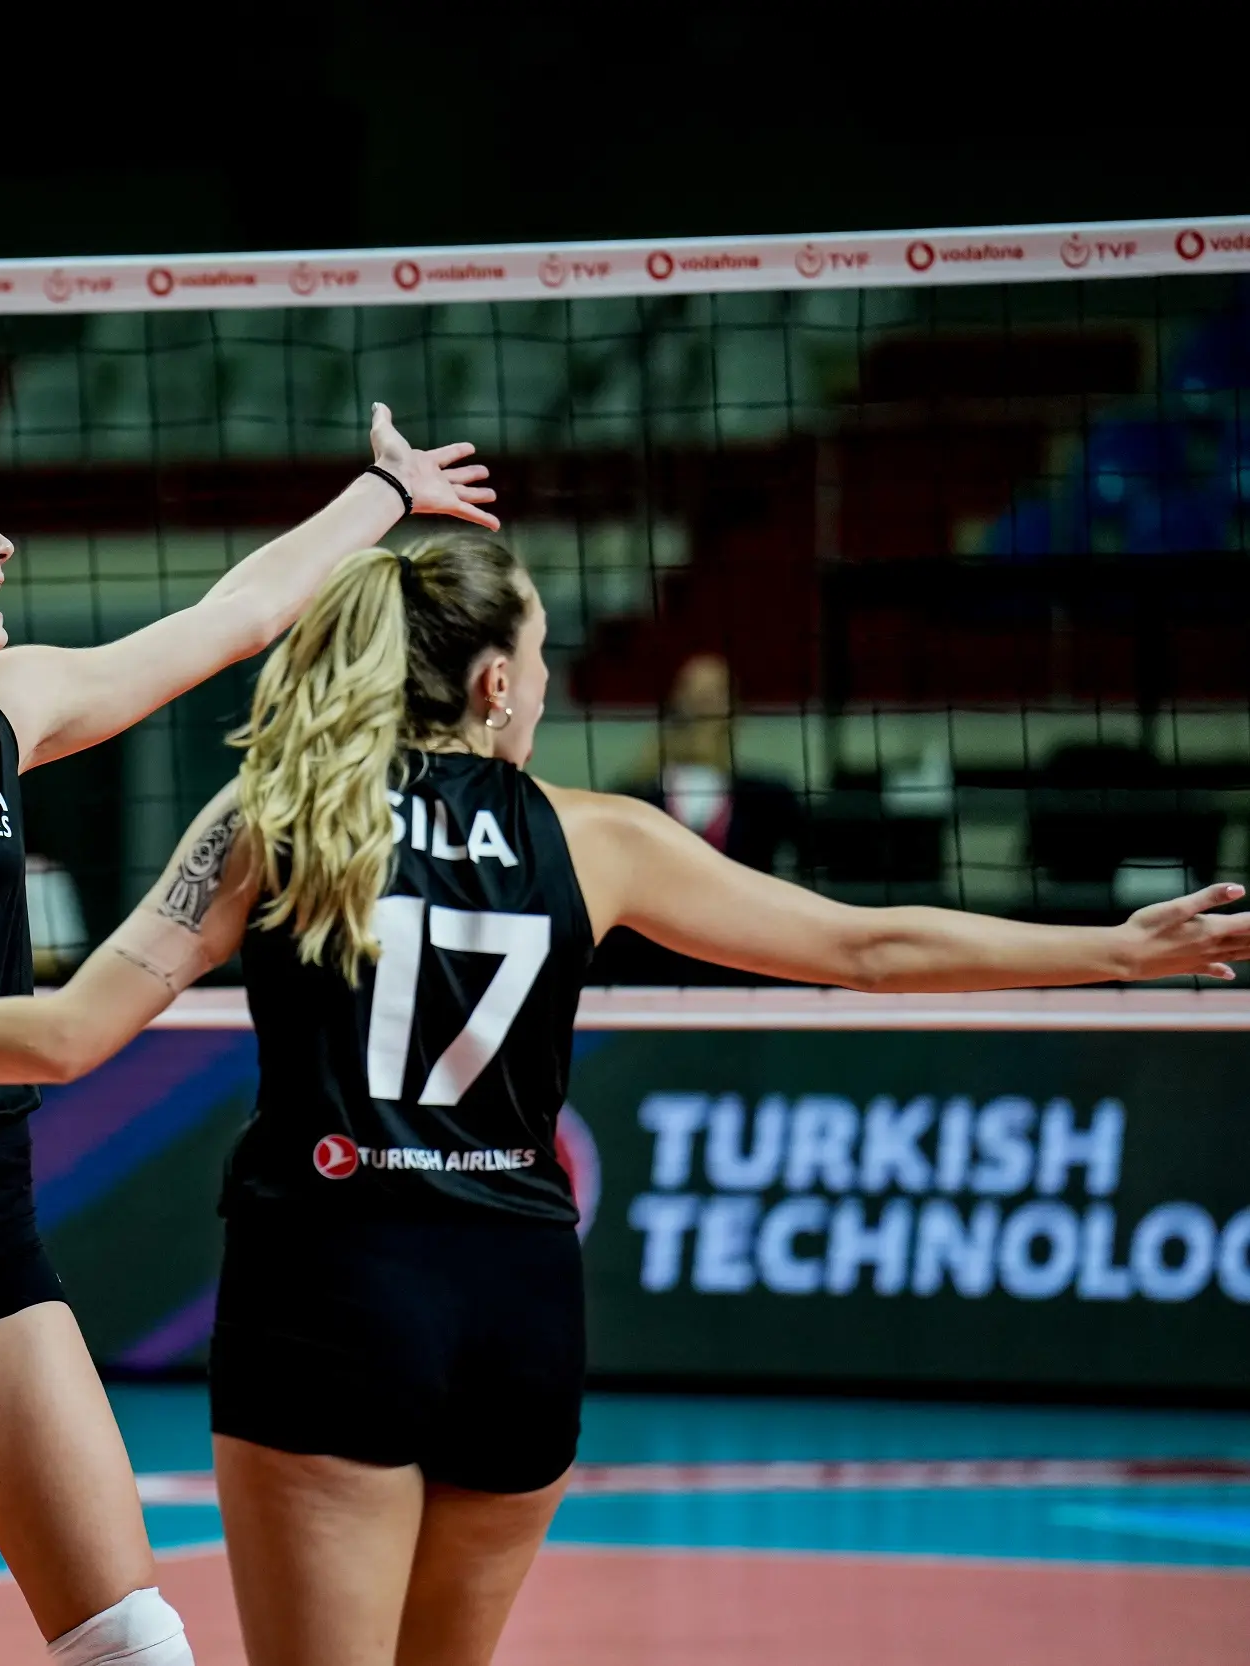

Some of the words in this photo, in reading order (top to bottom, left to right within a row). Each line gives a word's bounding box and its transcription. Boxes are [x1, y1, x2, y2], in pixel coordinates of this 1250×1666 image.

[426, 265, 504, 281] vodafone
[679, 255, 760, 271] vodafone
[830, 253, 869, 269] TVF
[940, 246, 1023, 262] vodafone
[1097, 243, 1137, 260] TVF
[367, 894, 551, 1106] 17
[357, 1147, 442, 1171] TURKISH
[639, 1093, 1125, 1196] TURKISH
